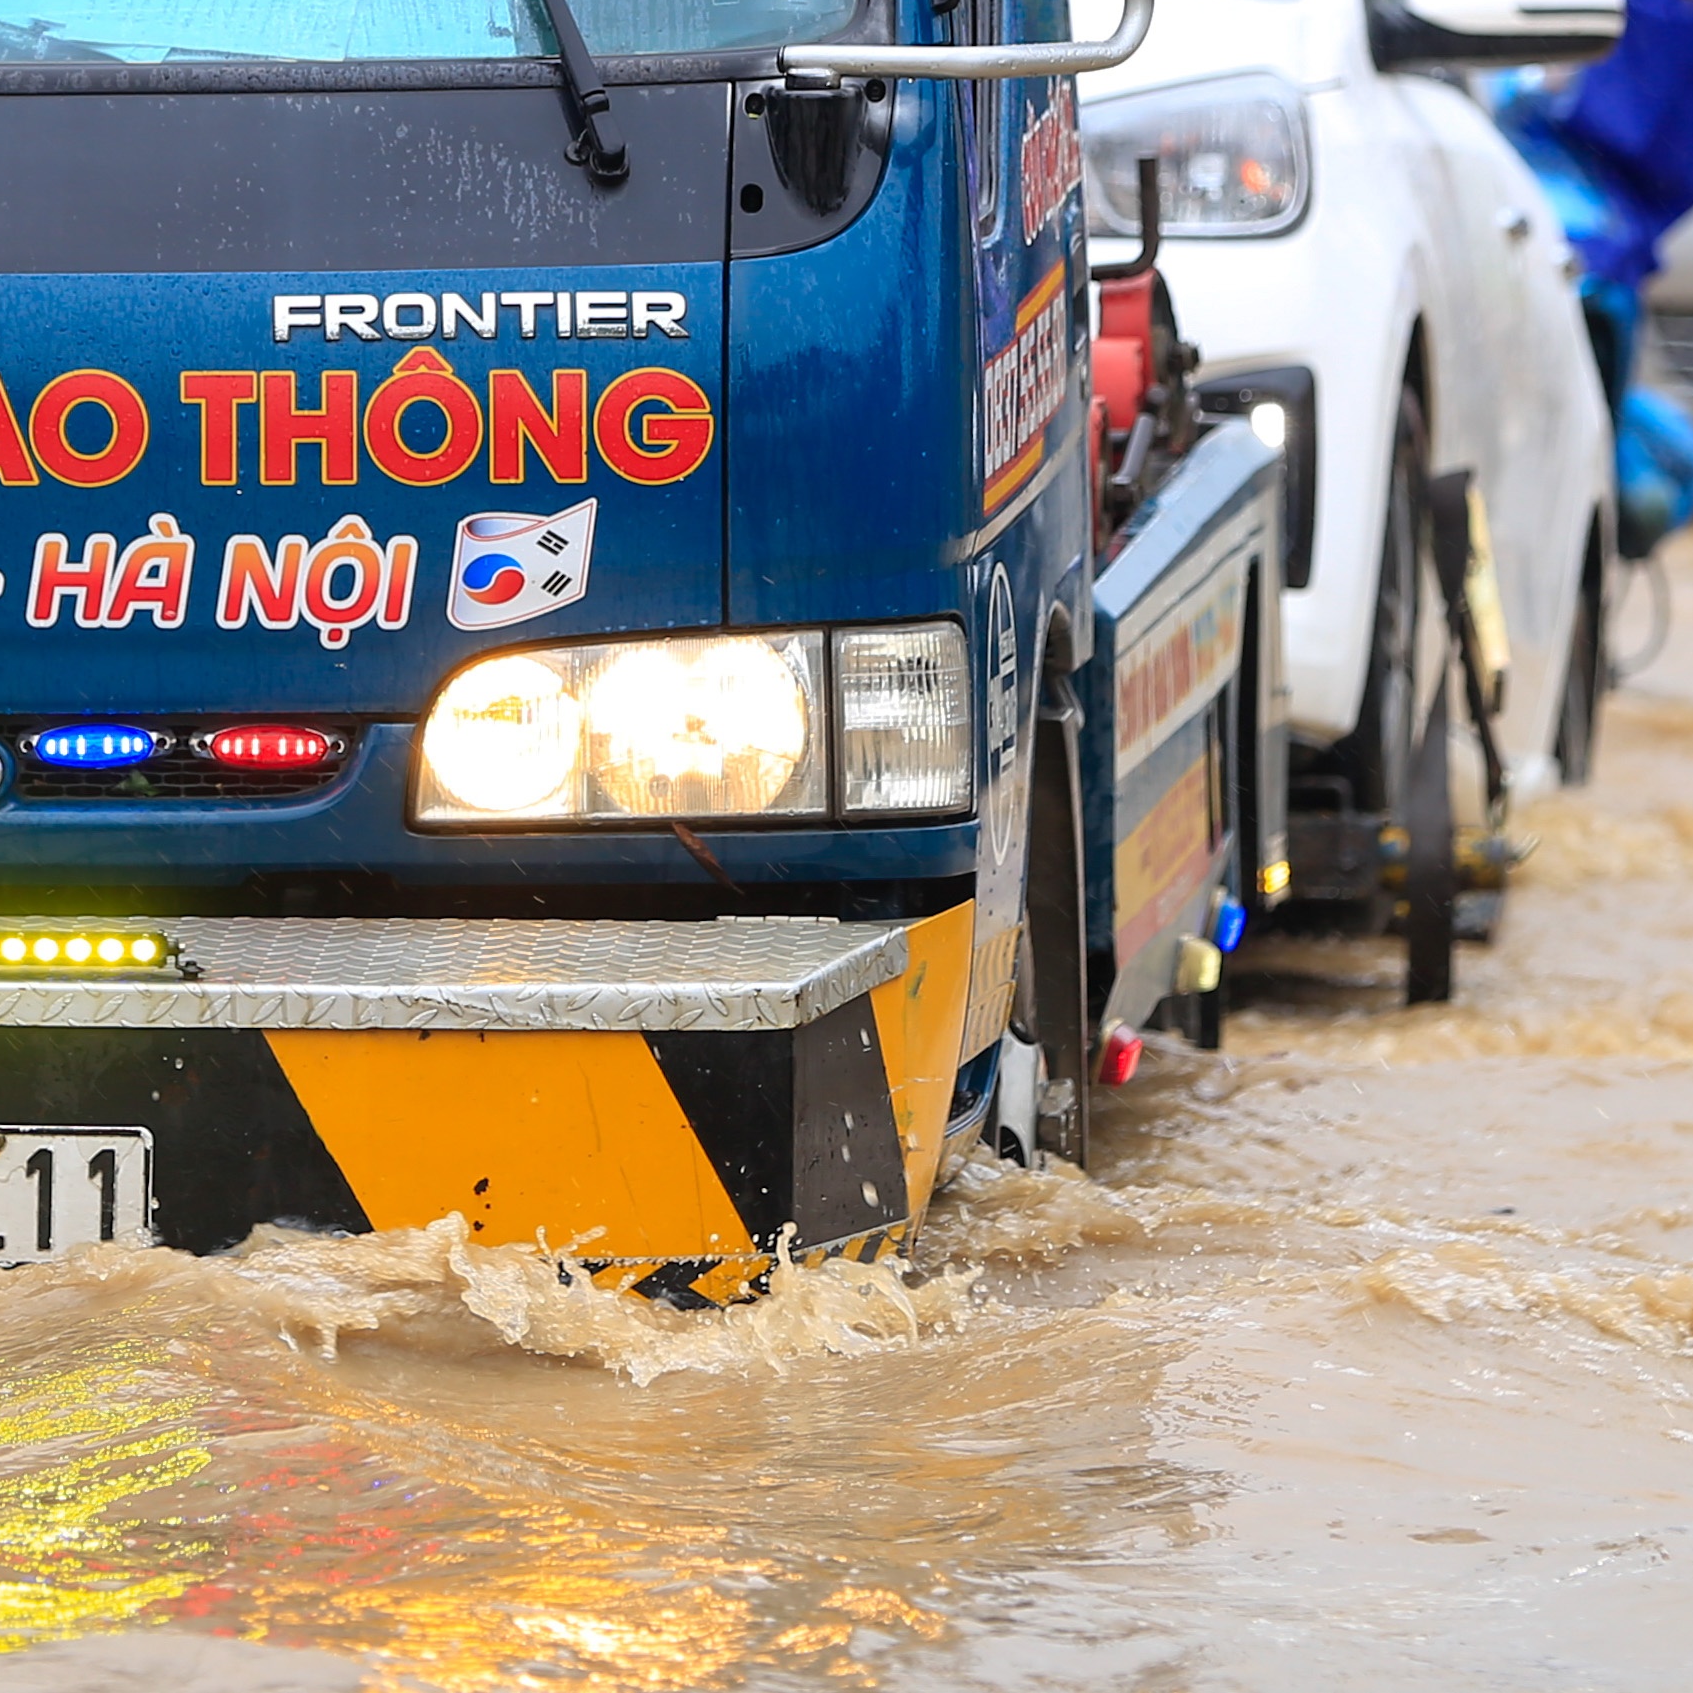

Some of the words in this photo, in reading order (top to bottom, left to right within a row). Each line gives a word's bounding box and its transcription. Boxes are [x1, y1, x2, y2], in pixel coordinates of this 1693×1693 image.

[274, 290, 690, 342] FRONTIER
[181, 346, 715, 487] THÔNG
[26, 513, 194, 630] HÀ
[216, 514, 418, 649] NỘI
